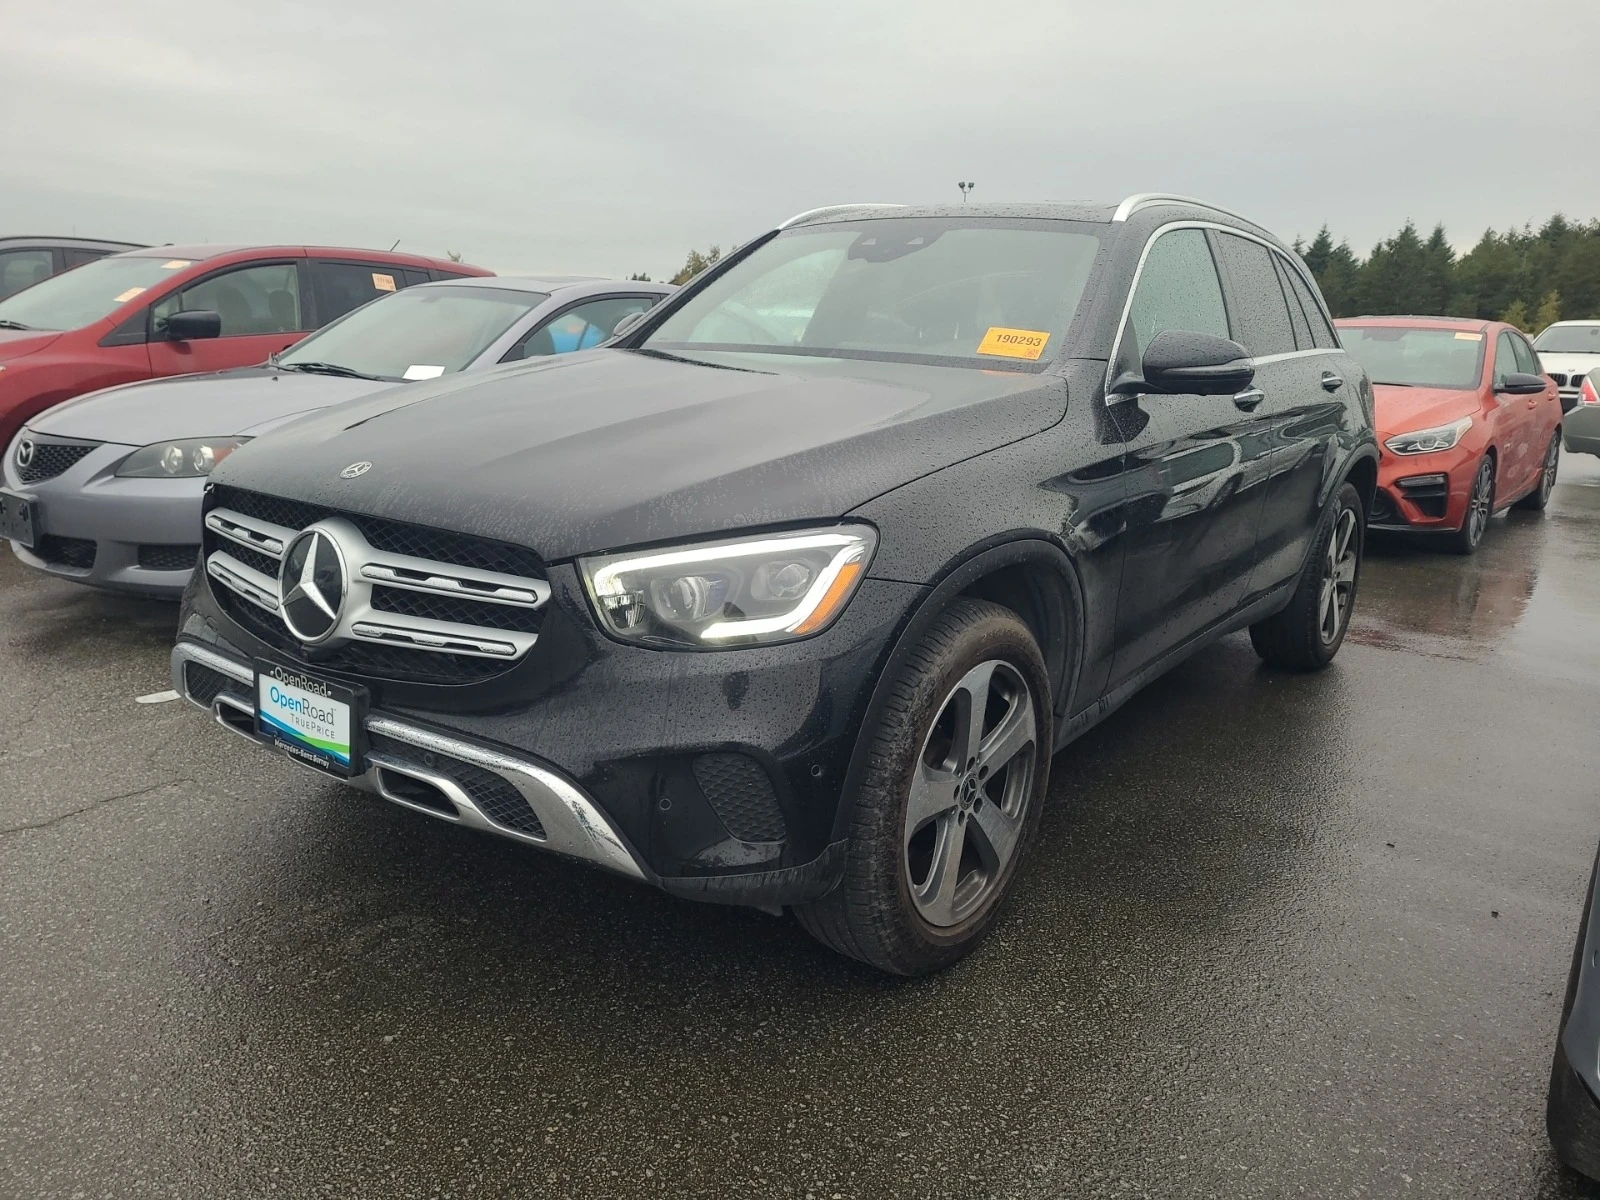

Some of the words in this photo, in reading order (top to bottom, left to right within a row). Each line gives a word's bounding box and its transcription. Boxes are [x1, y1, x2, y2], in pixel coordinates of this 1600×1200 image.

[996, 334, 1042, 346] 190293
[274, 666, 328, 697] OpenRoad
[270, 686, 335, 726] OpenRoad
[290, 713, 335, 739] TRUEPRICE
